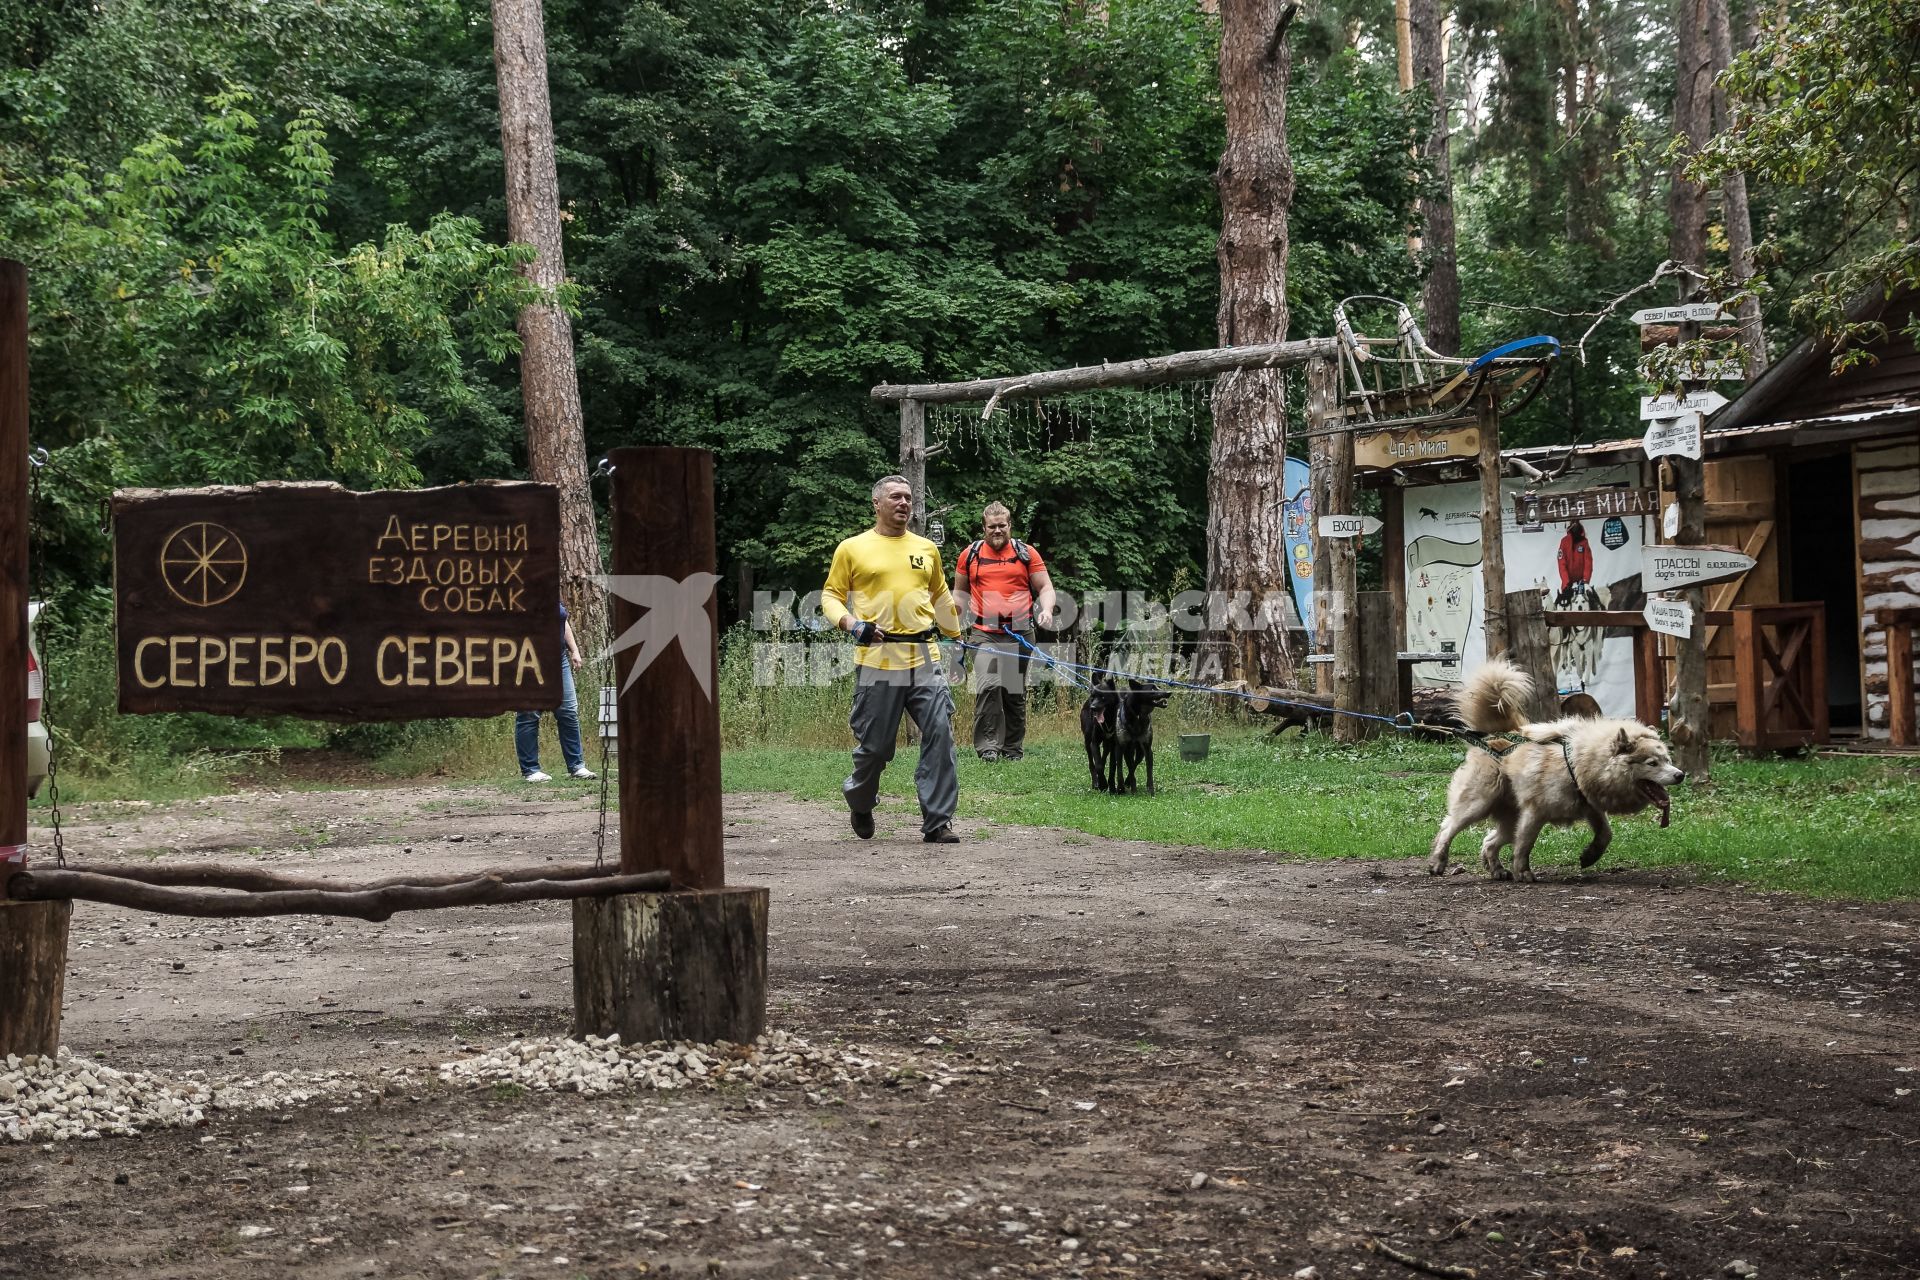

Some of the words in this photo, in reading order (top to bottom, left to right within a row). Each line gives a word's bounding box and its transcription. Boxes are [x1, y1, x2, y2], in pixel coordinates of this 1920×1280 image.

[1597, 491, 1659, 514] МИЛЯ
[377, 514, 528, 552] ДЕРЕВНЯ
[369, 557, 525, 585] ЕЗДОВЫХ
[1654, 558, 1700, 569] ТРАССЫ
[420, 585, 526, 613] СОБАК
[134, 635, 348, 688] СЕРЕБРО
[376, 635, 545, 686] СЕВЕРА
